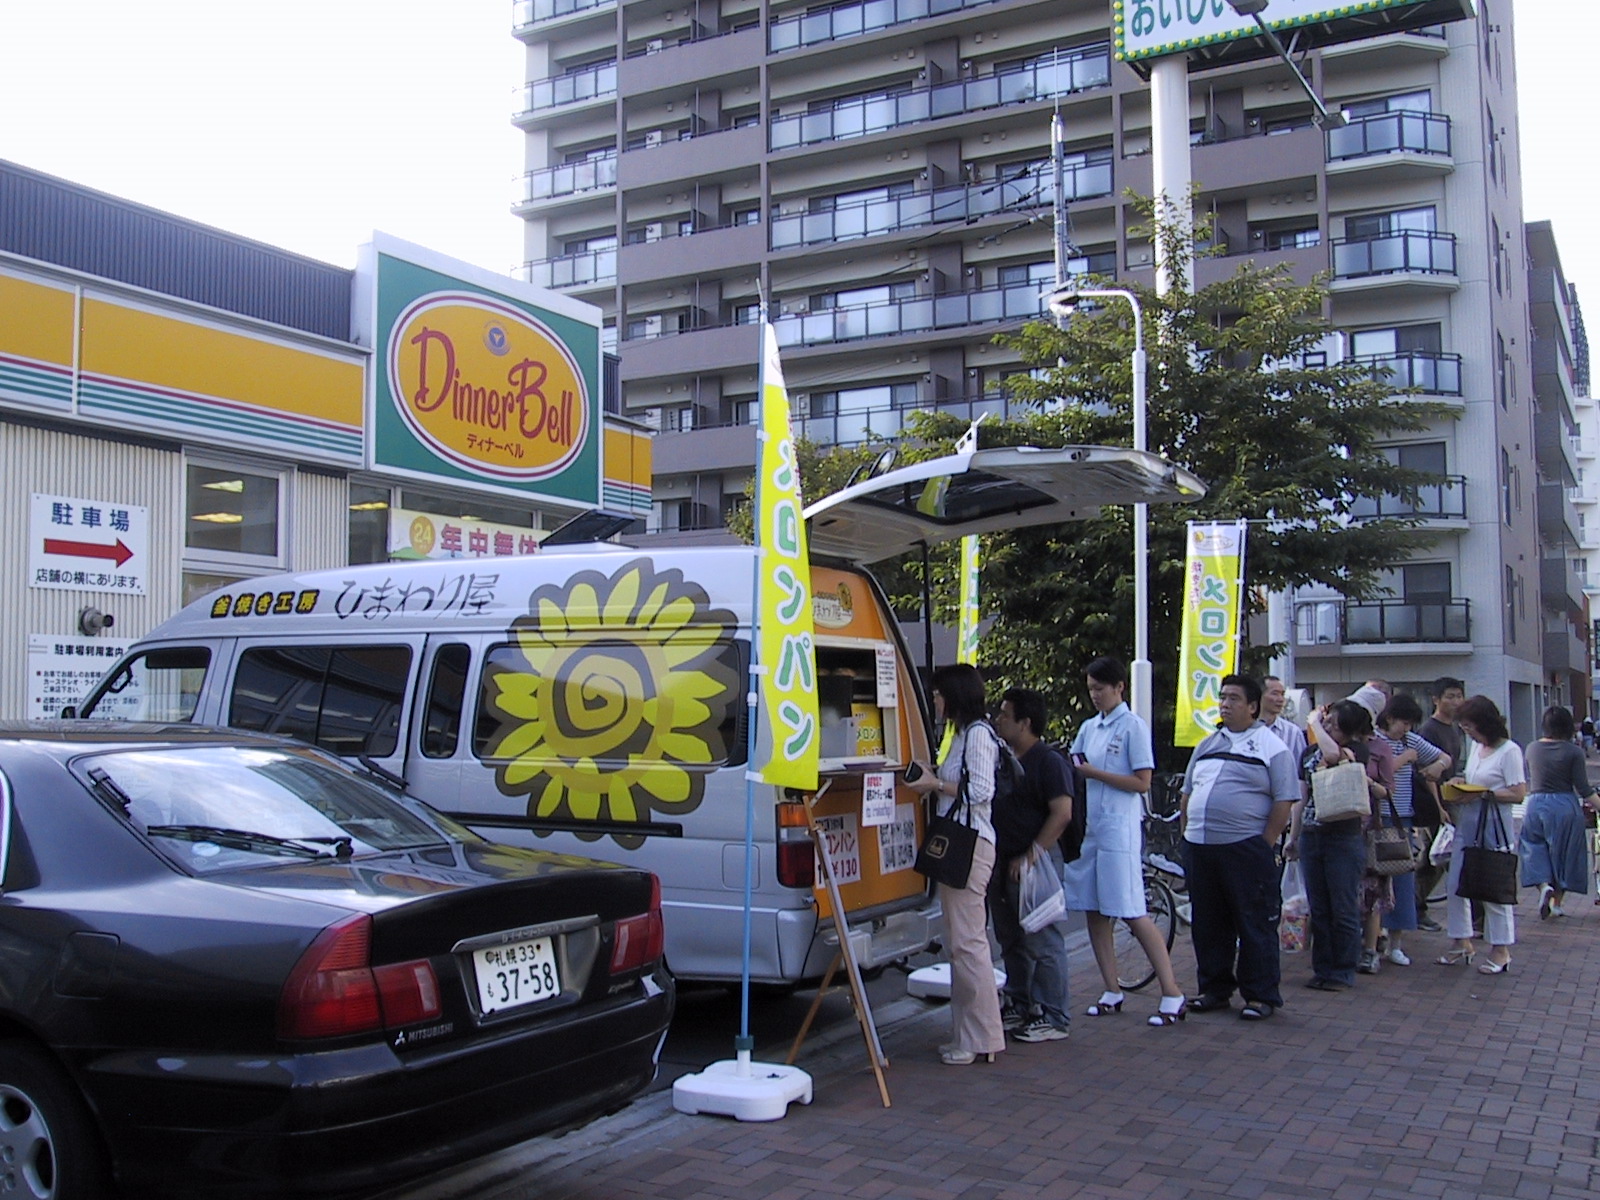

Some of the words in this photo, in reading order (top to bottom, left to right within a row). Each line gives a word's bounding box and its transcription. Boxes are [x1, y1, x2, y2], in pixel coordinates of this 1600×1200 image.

[411, 326, 514, 431] Dinner
[508, 358, 573, 446] Bell
[51, 502, 130, 532] 駐車場
[440, 522, 538, 557] 年中無休
[36, 568, 141, 589] 店舗の横にあります。
[334, 573, 500, 620] ひまわり屋
[496, 962, 554, 1003] 37-58
